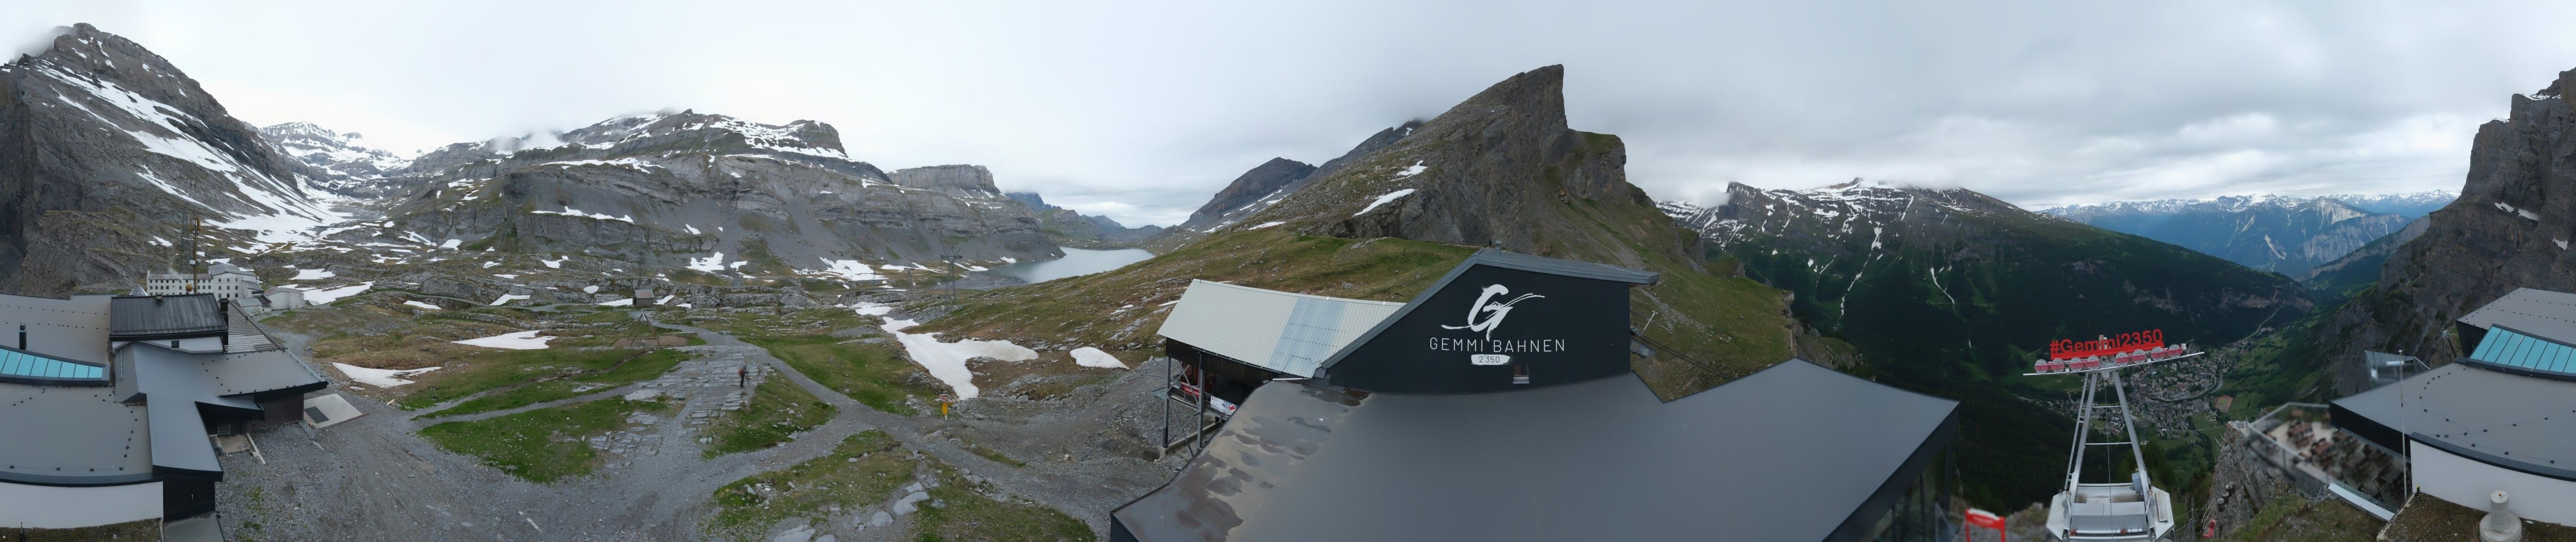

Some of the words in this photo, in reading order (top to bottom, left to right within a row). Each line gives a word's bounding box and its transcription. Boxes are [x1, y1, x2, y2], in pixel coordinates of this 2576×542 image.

[1430, 337, 1483, 352] GEMMI
[1493, 339, 1565, 353] BAHNEN
[2050, 329, 2163, 354] #Gemmi2350
[1479, 355, 1500, 364] 2'350
